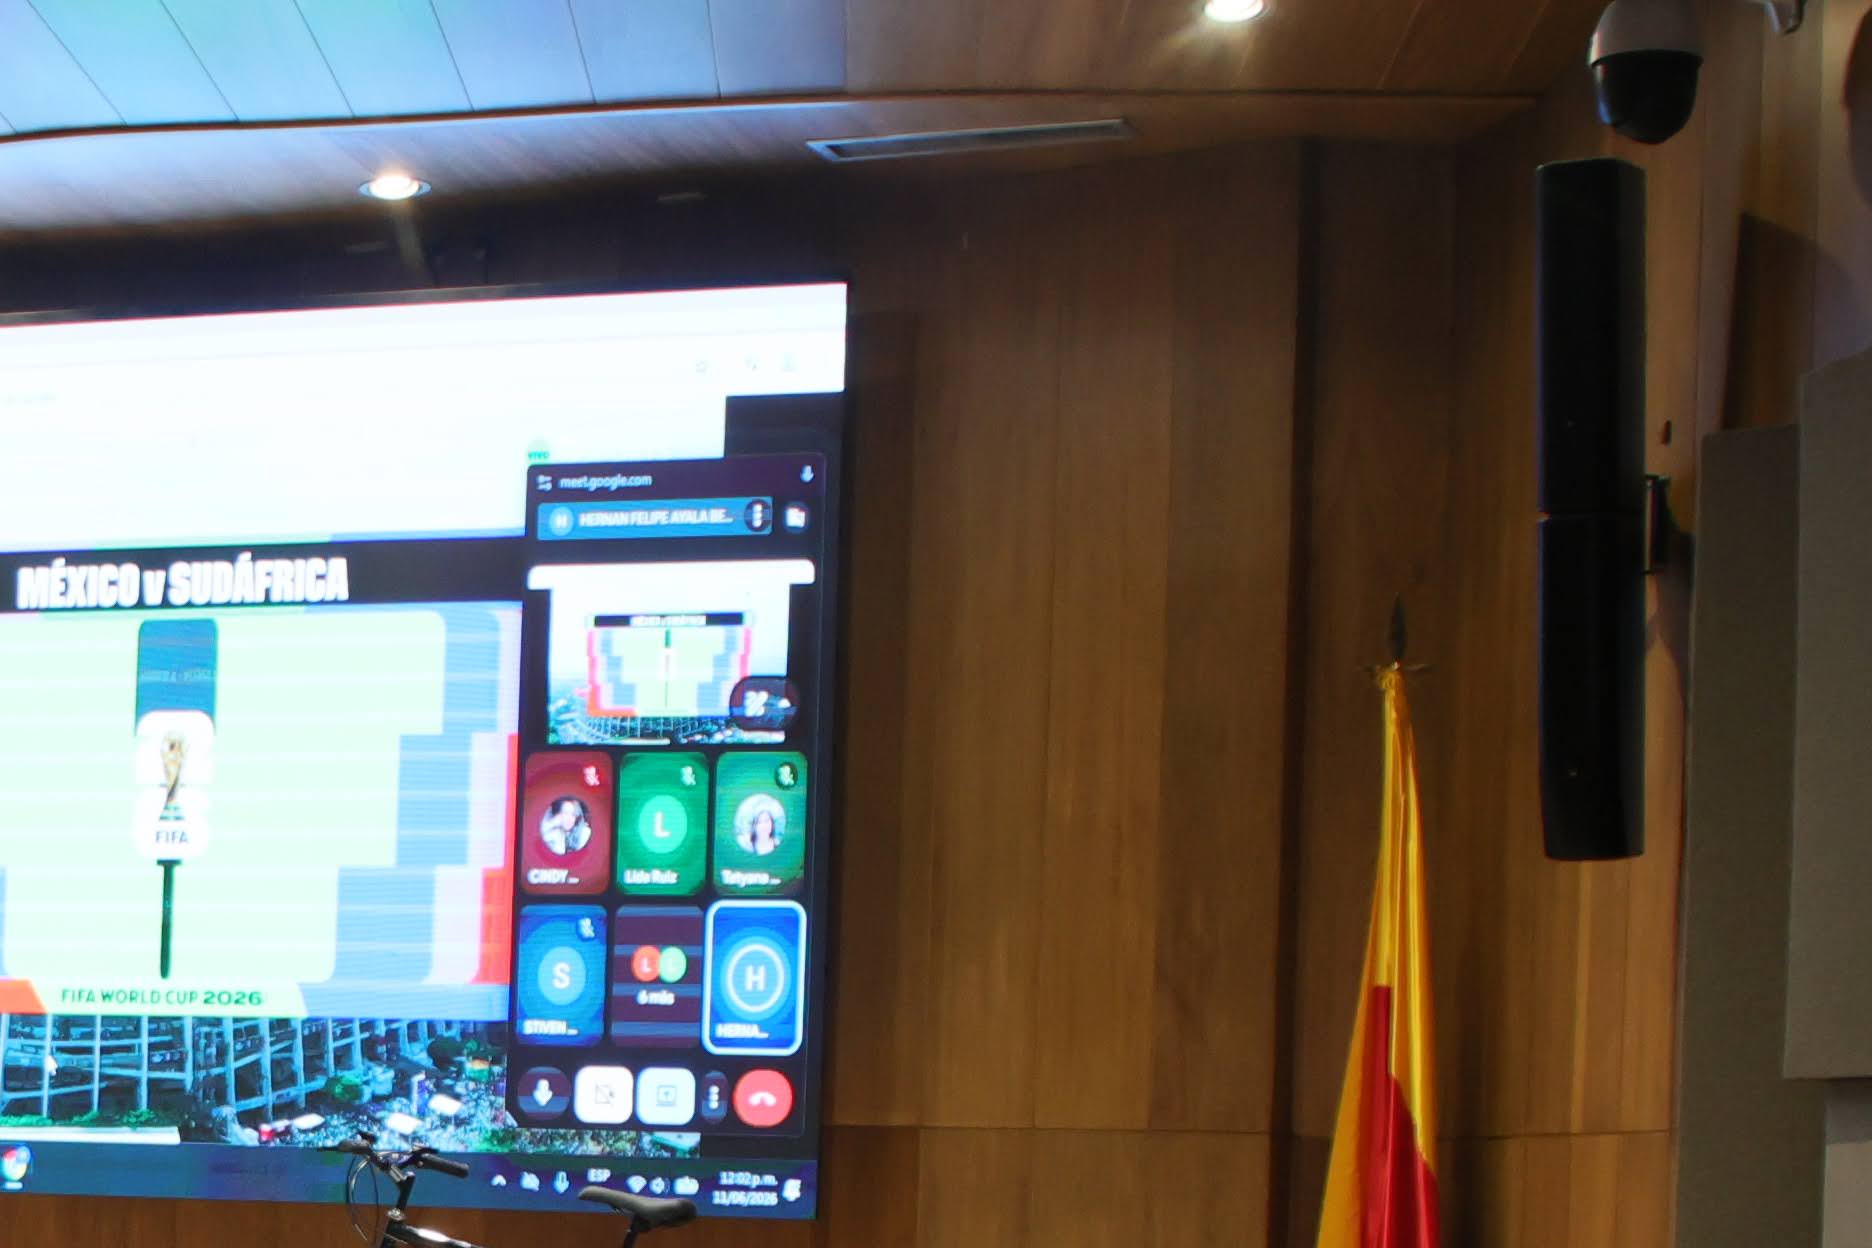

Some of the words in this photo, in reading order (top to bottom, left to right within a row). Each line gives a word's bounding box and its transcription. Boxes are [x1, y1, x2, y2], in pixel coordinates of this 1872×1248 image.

[559, 474, 653, 491] meet.google.com
[579, 511, 629, 527] HERNAN
[630, 510, 668, 525] FELIPE
[669, 509, 707, 524] AYALA
[16, 557, 141, 609] MÉXICO
[168, 551, 349, 606] SUDÁFRICA
[655, 811, 672, 837] L
[155, 831, 189, 844] FIFA
[552, 963, 571, 989] S
[745, 966, 766, 991] H
[61, 989, 95, 1004] FIFA
[101, 989, 161, 1005] WORLD
[166, 989, 198, 1005] CUP
[203, 991, 262, 1006] 2026
[587, 1168, 612, 1183] ESP
[712, 1190, 778, 1207] 11/06/2026
